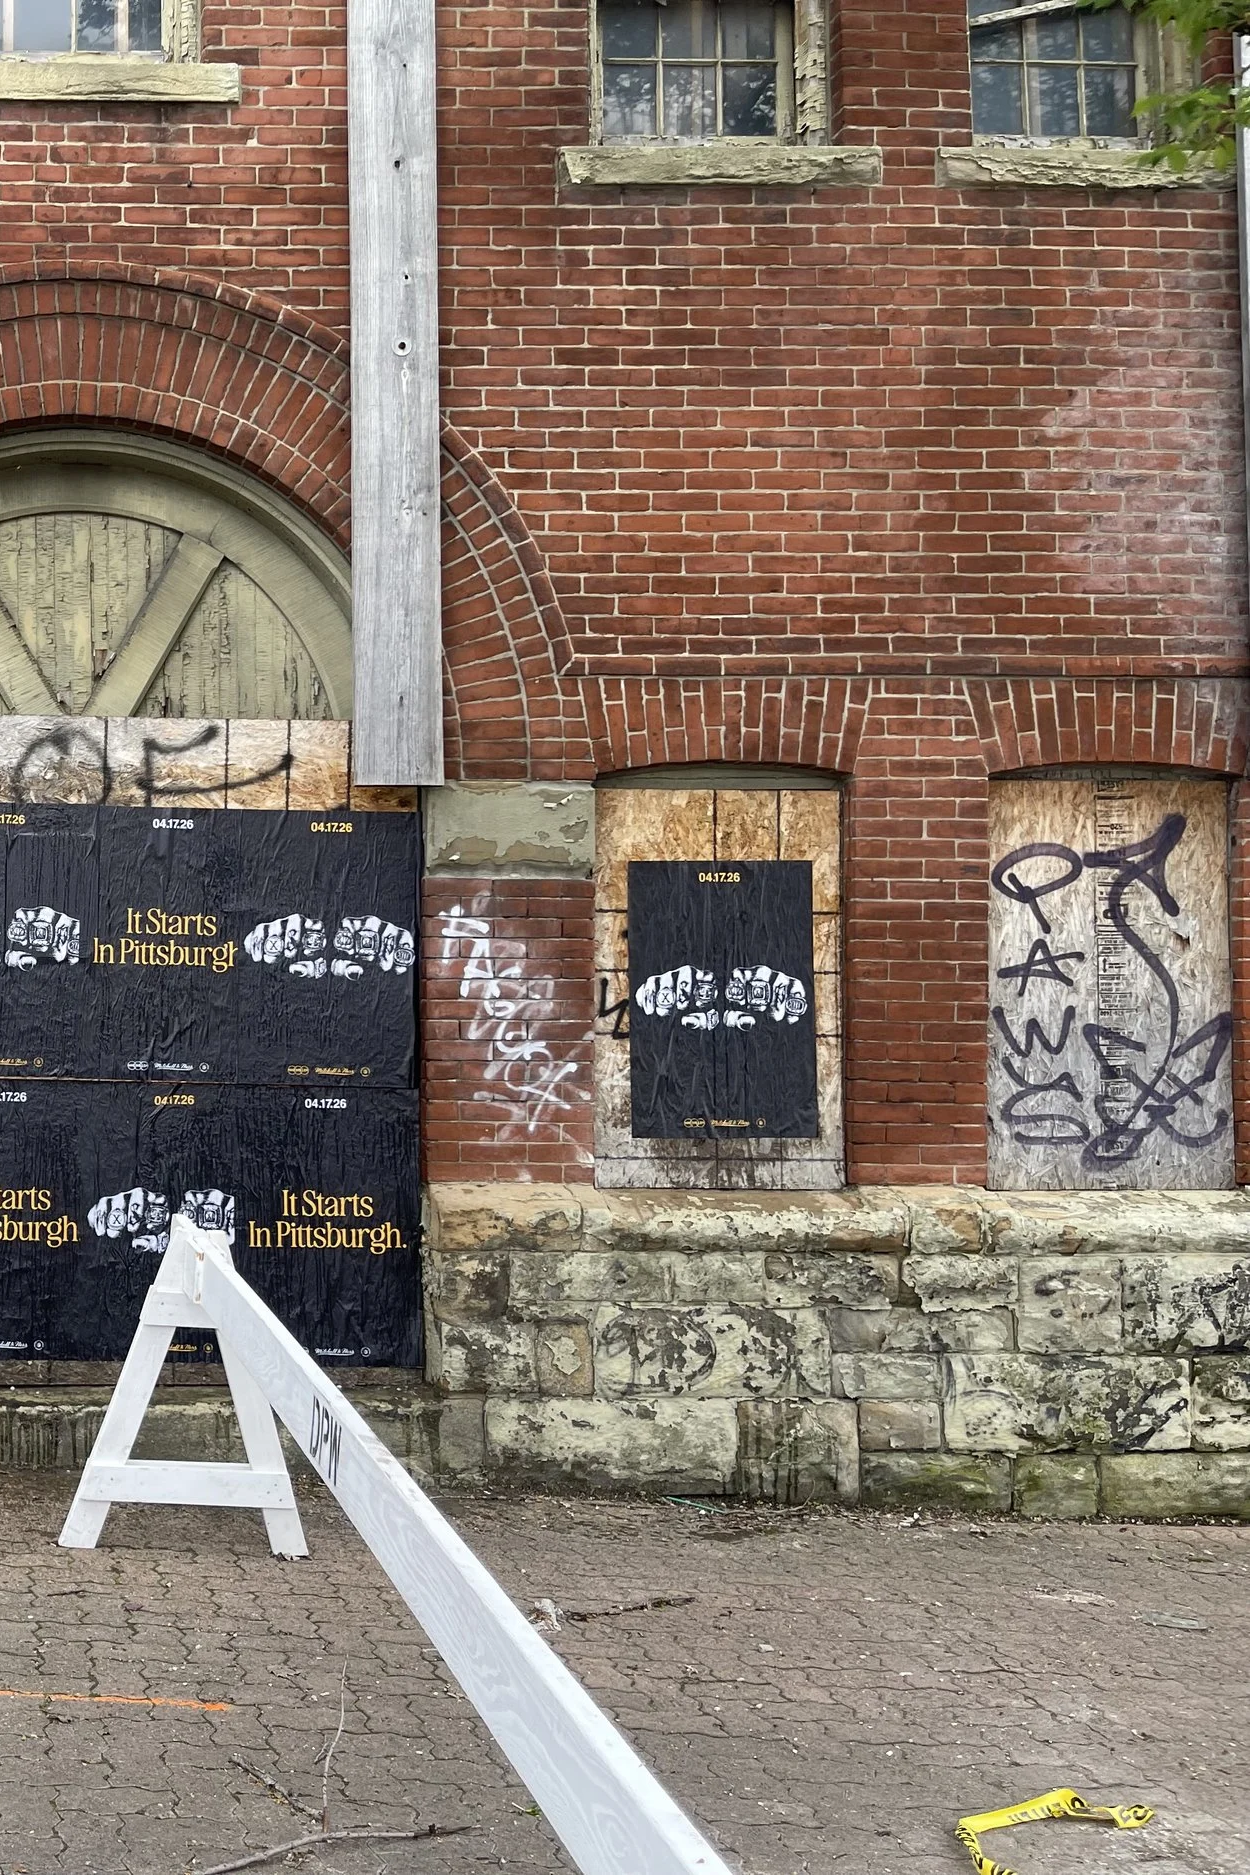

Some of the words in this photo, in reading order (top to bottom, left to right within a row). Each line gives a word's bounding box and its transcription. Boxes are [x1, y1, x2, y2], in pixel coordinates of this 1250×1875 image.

[152, 818, 195, 830] 04.17.26
[310, 821, 353, 833] 04.17.26
[698, 871, 741, 883] 04.17.26
[127, 908, 142, 934] It
[146, 908, 216, 935] Starts
[93, 938, 114, 963] In
[153, 1094, 195, 1107] 04.17.26
[304, 1098, 347, 1109] 04.17.26
[282, 1189, 298, 1216] It
[302, 1189, 373, 1217] Starts
[249, 1220, 271, 1247] In
[276, 1220, 407, 1254] Pittsburgh.
[310, 1395, 342, 1487] DPW
